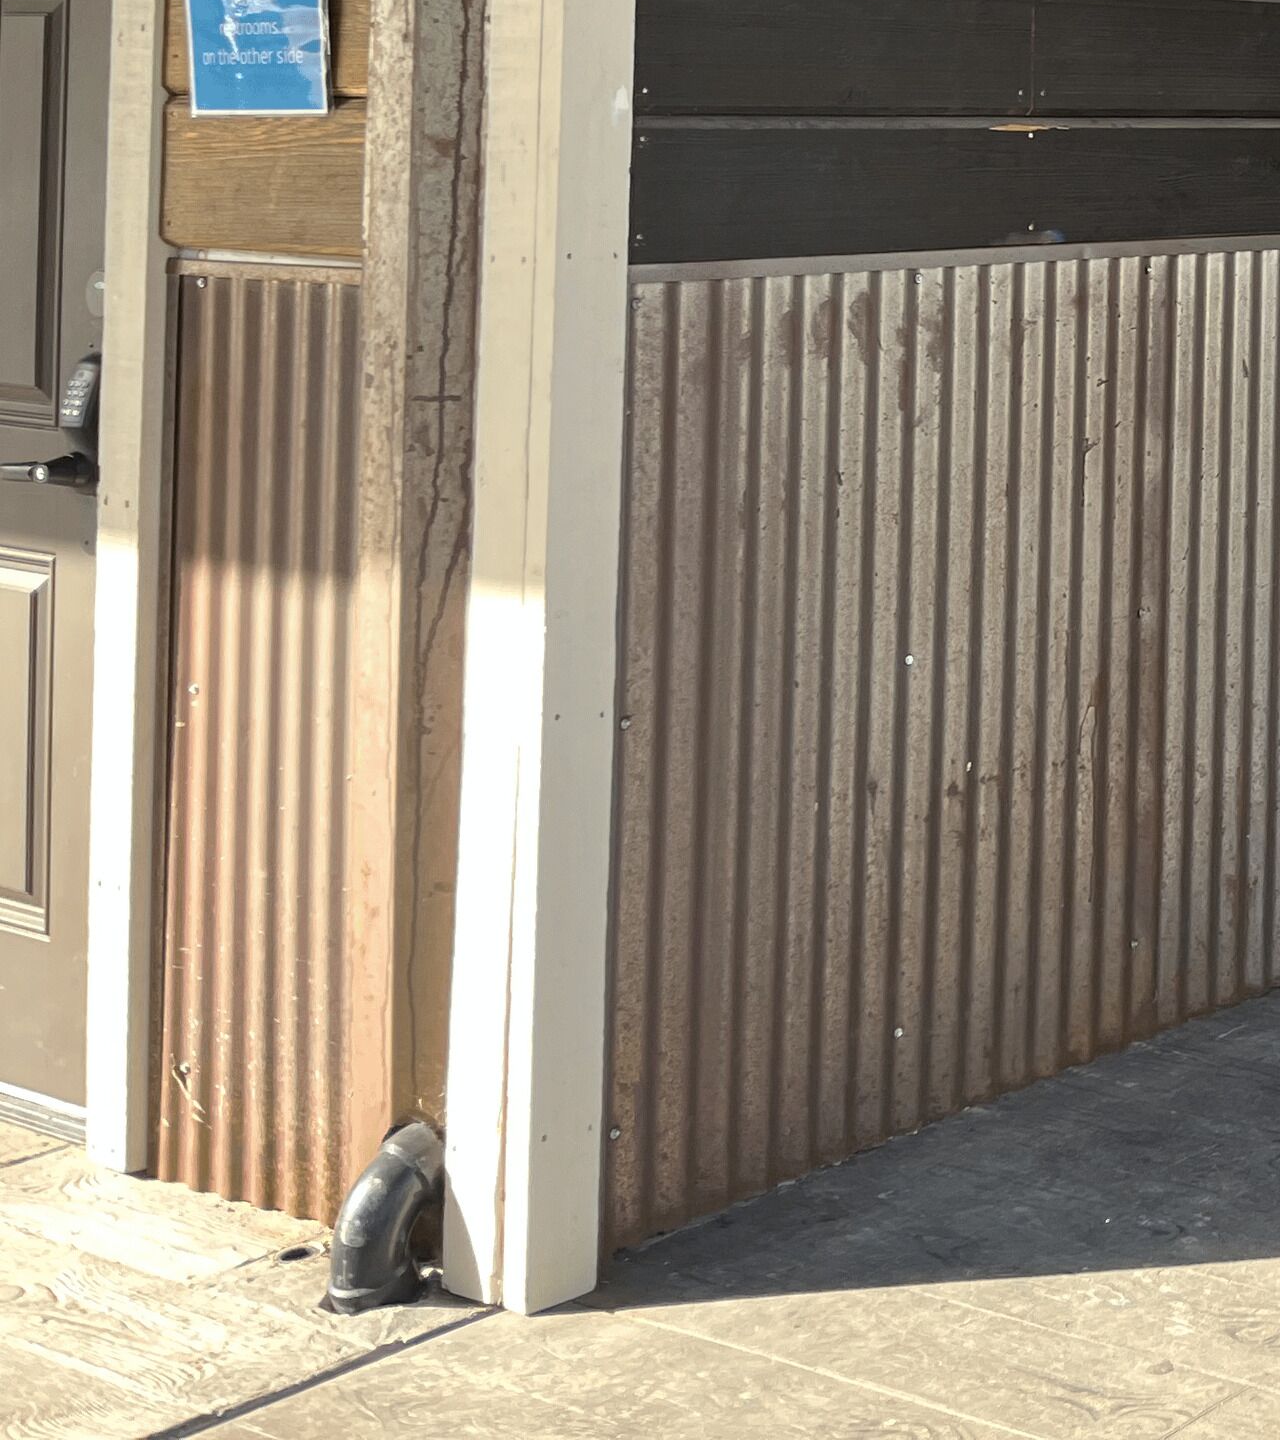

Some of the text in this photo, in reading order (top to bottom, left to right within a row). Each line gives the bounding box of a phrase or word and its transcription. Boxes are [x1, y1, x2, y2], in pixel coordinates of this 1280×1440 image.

[219, 21, 278, 35] rtrooms
[202, 46, 304, 65] on the other side
